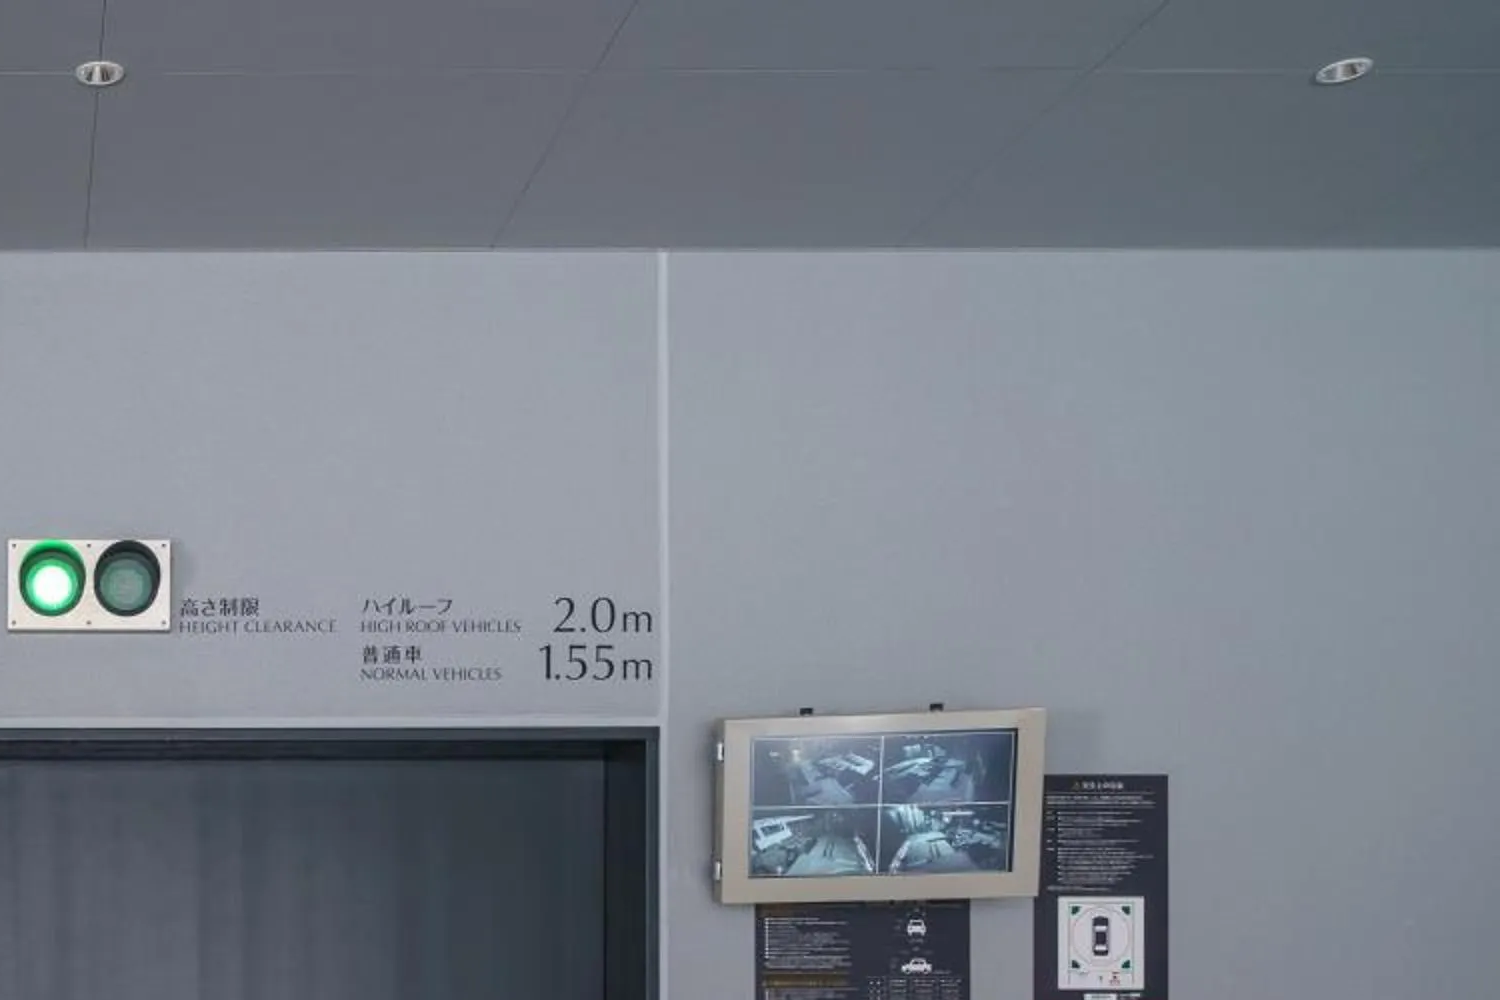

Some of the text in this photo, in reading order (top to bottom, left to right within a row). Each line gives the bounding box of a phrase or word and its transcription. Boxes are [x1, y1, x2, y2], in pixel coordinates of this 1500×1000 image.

[180, 598, 260, 618] 高さ制限
[362, 598, 453, 616] ハイルーフ
[553, 597, 653, 633] 2.0m
[179, 619, 338, 633] HEIGHT CLEARANCE
[361, 619, 522, 633] HIGH ROOF VEHICLES
[362, 645, 422, 665] 普通車
[539, 644, 653, 680] 1.55m
[360, 667, 503, 681] NORMAL VEHICLES
